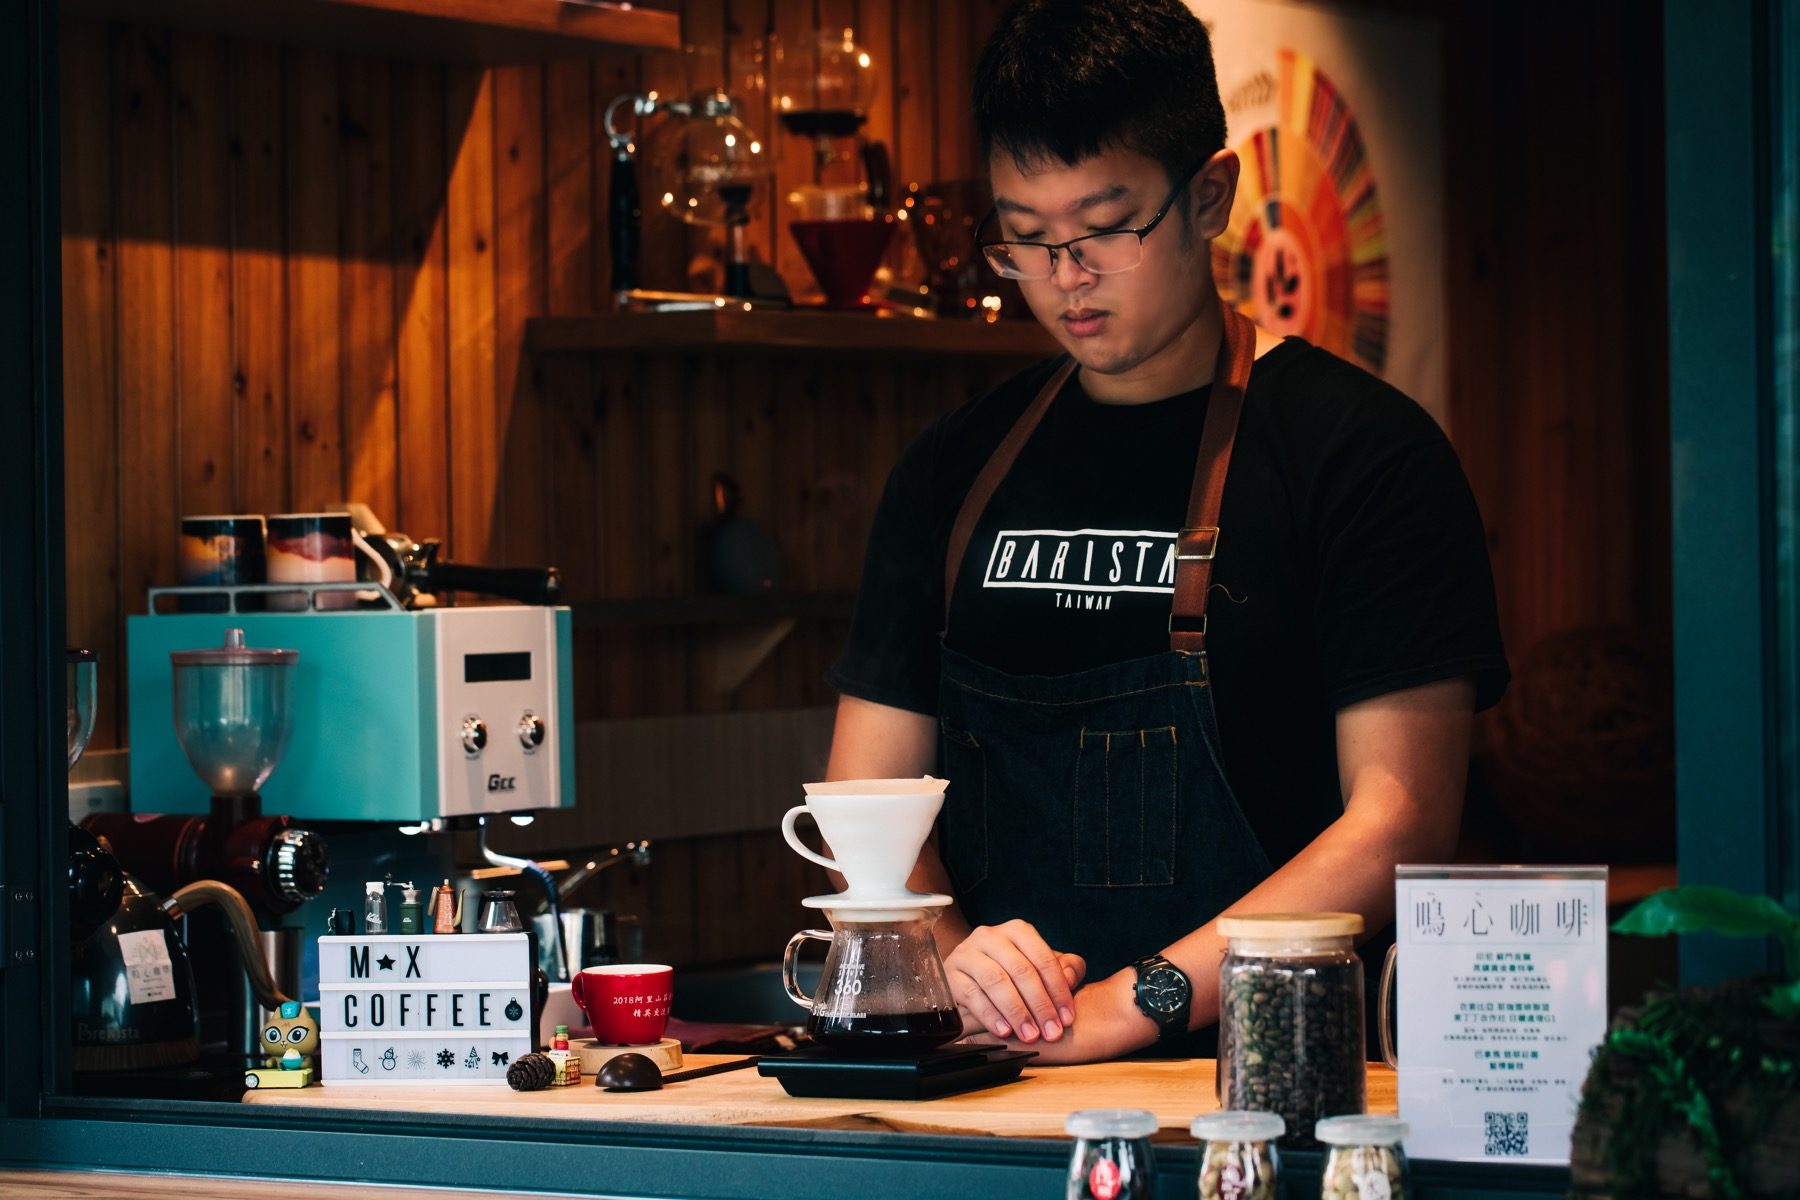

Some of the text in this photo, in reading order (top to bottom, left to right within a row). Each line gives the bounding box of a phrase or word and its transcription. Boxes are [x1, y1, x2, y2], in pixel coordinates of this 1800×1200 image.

[1055, 592, 1112, 610] TAIWAN
[834, 979, 862, 996] 360
[344, 993, 491, 1028] COFFEE
